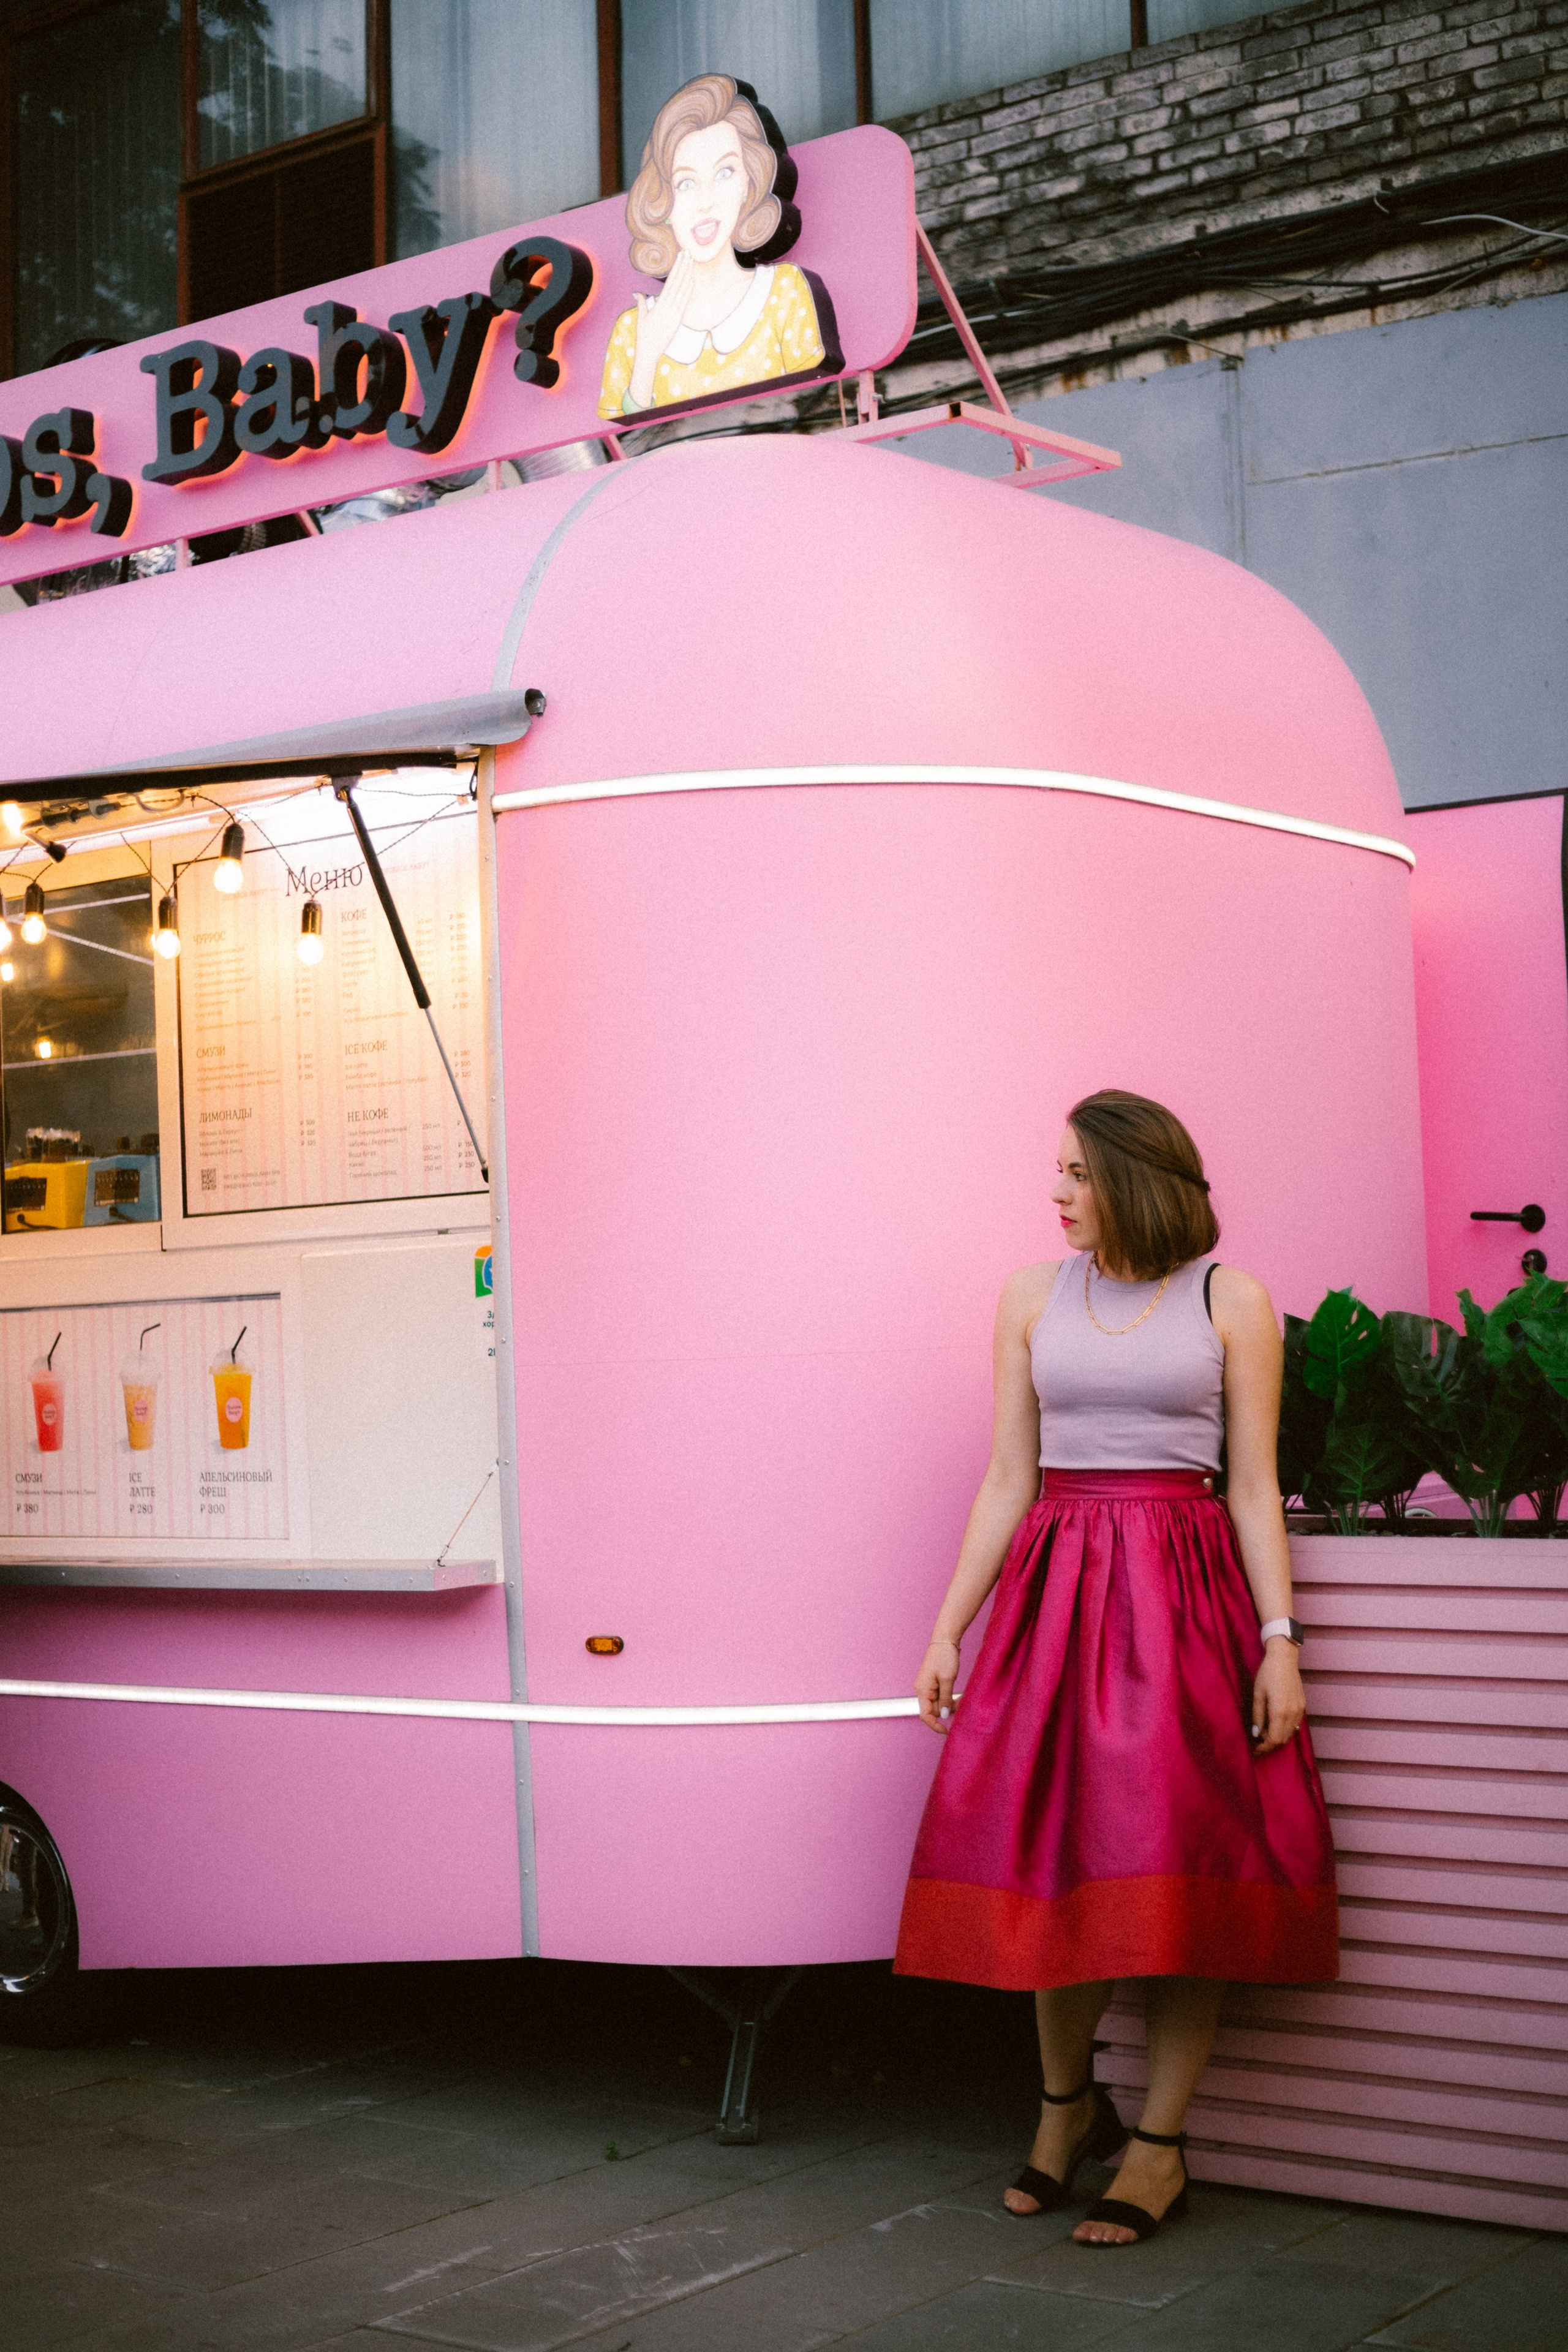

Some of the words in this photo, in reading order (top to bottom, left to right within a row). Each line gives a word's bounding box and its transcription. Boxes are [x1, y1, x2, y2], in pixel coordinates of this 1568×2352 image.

[0, 407, 135, 537] s,
[140, 236, 593, 485] Baby?
[285, 865, 363, 897] Меню
[341, 909, 367, 923] КОФЕ
[194, 930, 227, 944] ЧУРРОС
[196, 1045, 225, 1059] СМУЗИ
[345, 1043, 360, 1055] ICE
[361, 1040, 388, 1053] КОФЕ
[199, 1107, 252, 1123] ЛИМОНАДЫ
[347, 1111, 360, 1123] НЕ
[362, 1107, 389, 1120] КОФЕ
[15, 1473, 43, 1483] СМУЗИ
[129, 1472, 142, 1483] ICE
[200, 1469, 273, 1483] АПЕЛЬСИНОВЫЙ
[129, 1487, 156, 1498] ЛАТТЕ
[199, 1486, 227, 1498] ФРЕШ
[23, 1503, 39, 1514] 380
[137, 1504, 153, 1514] 280
[208, 1504, 225, 1514] 300
